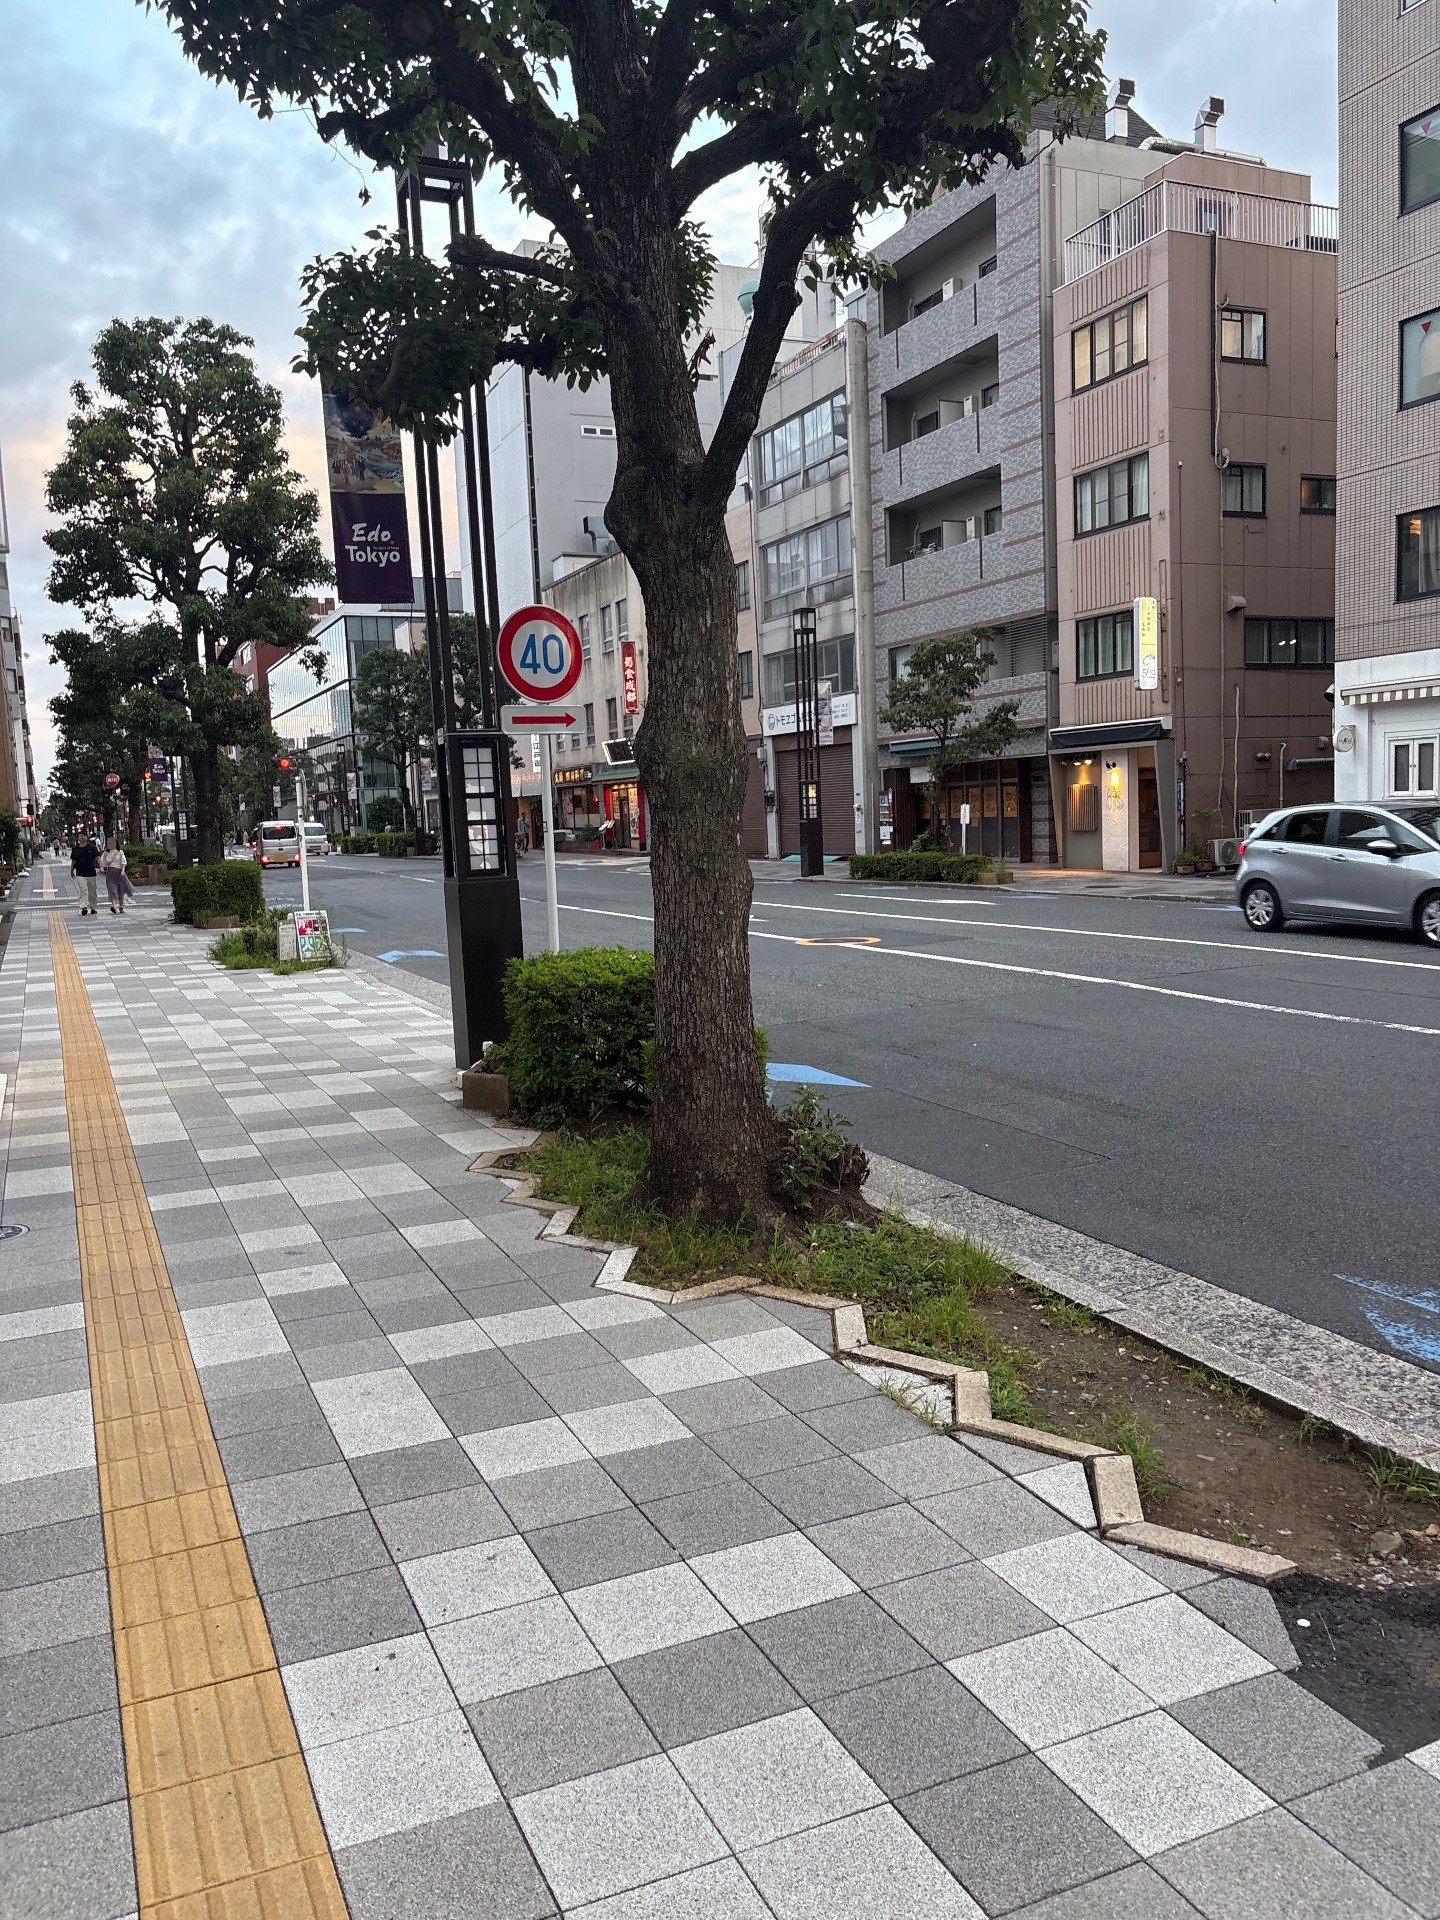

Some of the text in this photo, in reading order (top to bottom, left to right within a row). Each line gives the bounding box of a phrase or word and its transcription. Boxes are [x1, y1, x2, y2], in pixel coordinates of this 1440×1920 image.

[351, 522, 392, 542] Edo
[344, 545, 401, 568] Tokyo
[519, 633, 565, 675] 40
